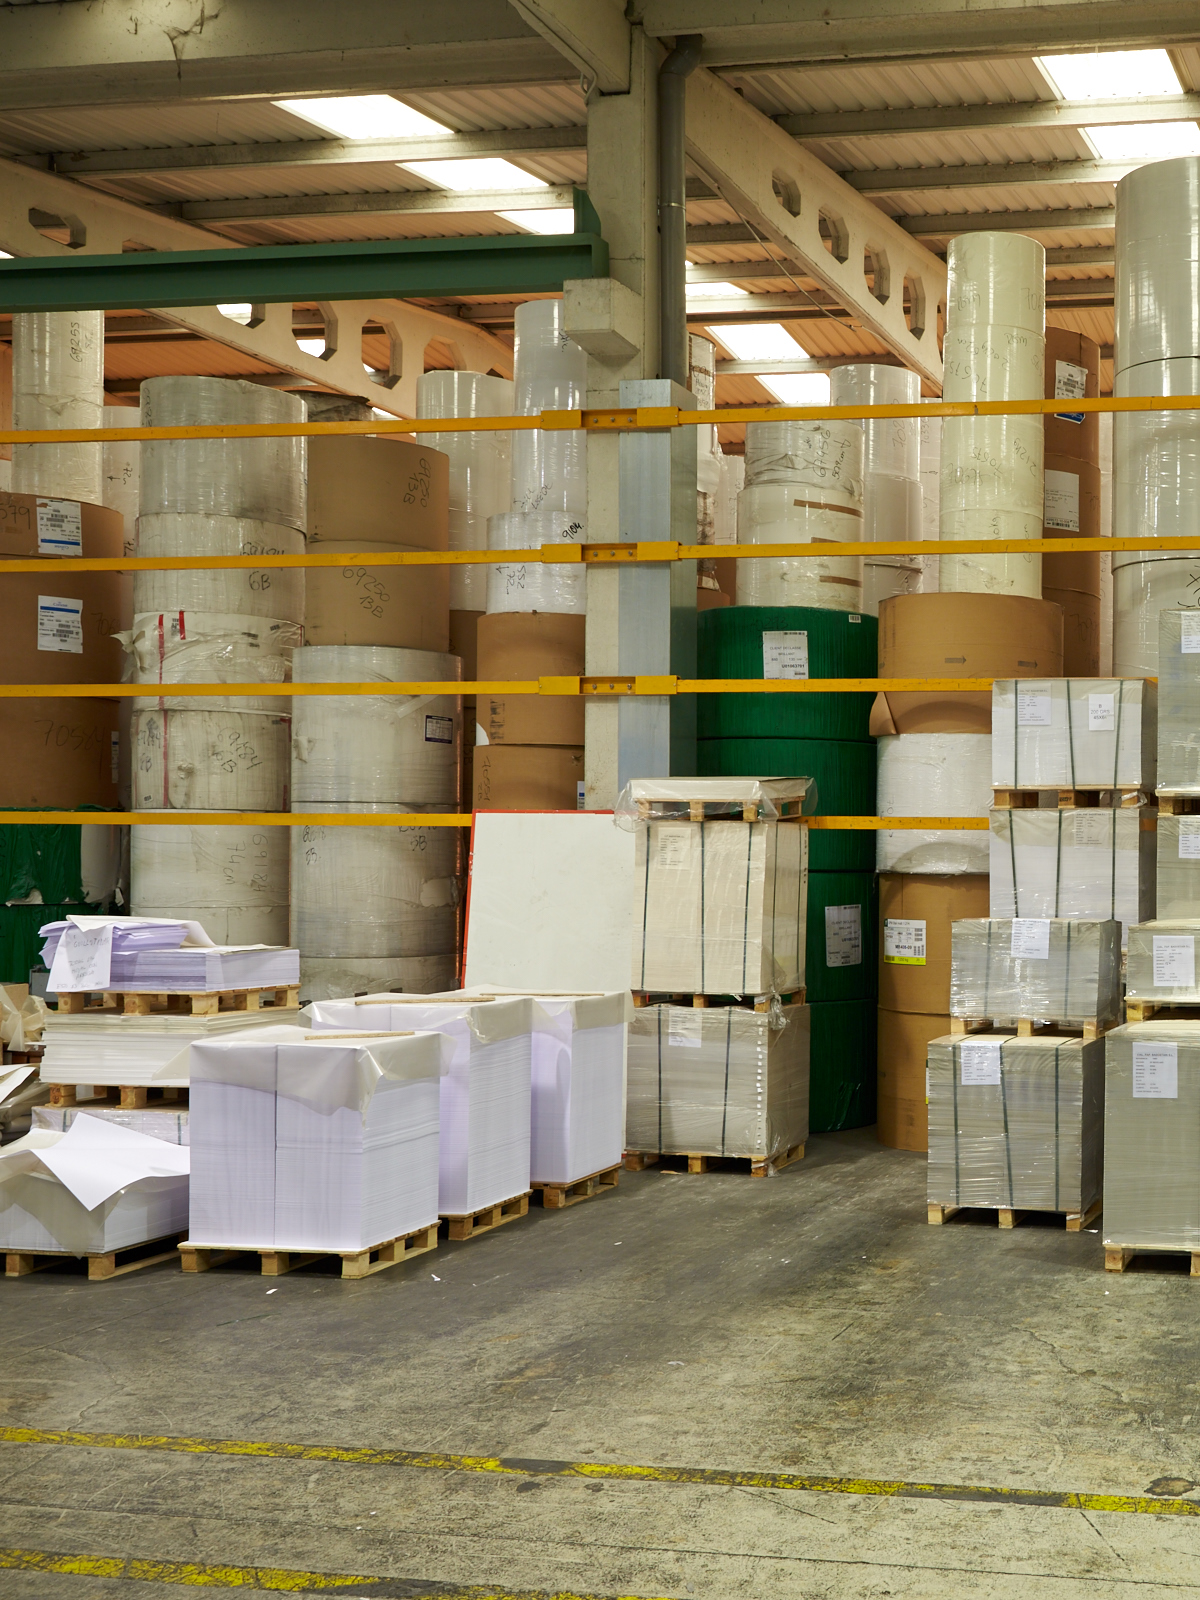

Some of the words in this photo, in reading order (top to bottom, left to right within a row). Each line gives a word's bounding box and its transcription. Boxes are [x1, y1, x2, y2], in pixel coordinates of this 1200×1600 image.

[248, 570, 271, 591] 6B
[342, 565, 391, 602] 69250
[359, 594, 384, 619] 13B
